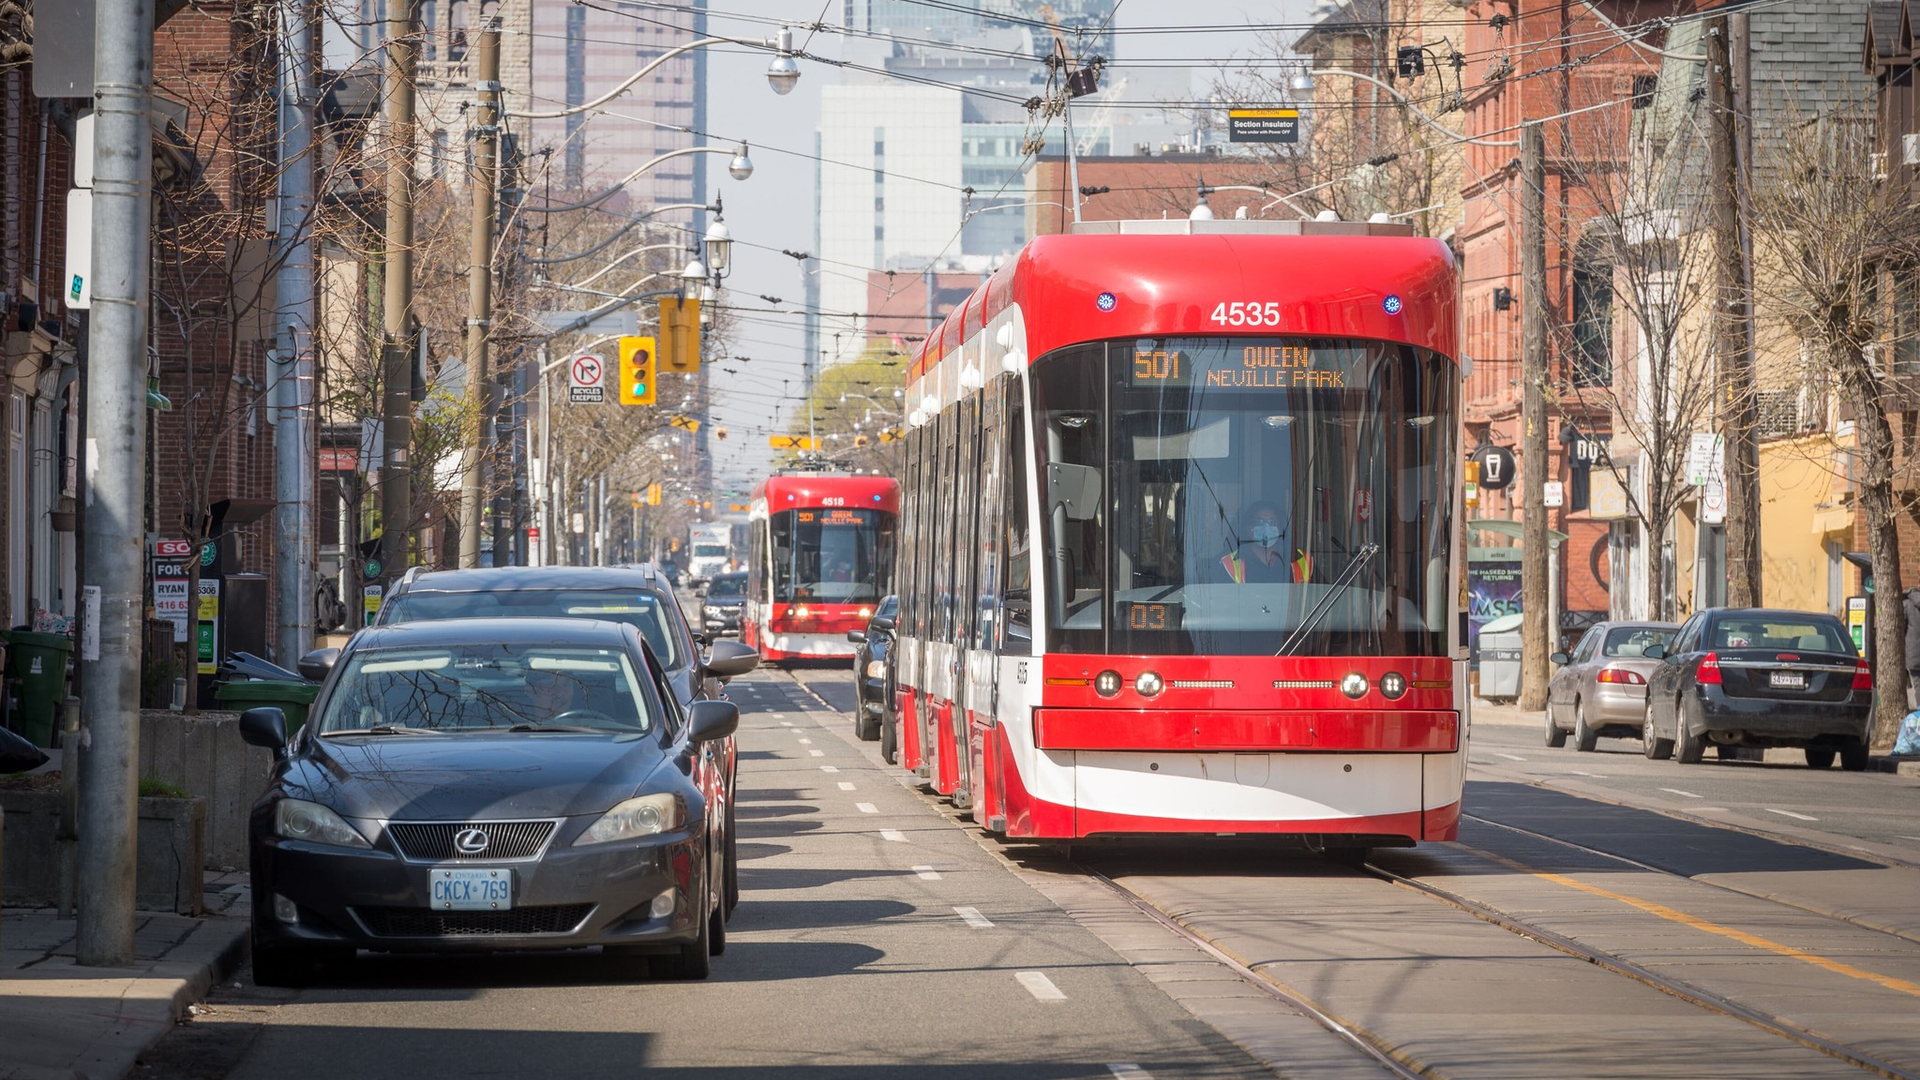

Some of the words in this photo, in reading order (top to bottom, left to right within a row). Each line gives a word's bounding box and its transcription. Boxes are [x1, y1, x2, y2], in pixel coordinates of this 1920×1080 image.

[1210, 302, 1280, 326] 4535
[1244, 347, 1308, 369] QUEEN
[1134, 352, 1180, 379] 501
[1207, 370, 1287, 387] NEVILLE
[1293, 370, 1344, 388] PARK
[822, 497, 845, 507] 4518
[798, 512, 814, 522] 501
[157, 564, 182, 576] FOR
[157, 584, 185, 594] RYAN
[158, 600, 176, 610] 416
[1130, 604, 1166, 630] 03
[1497, 650, 1512, 659] Litter
[454, 872, 488, 880] ONTARIO
[435, 880, 471, 901] CKCX
[480, 880, 508, 900] 769
